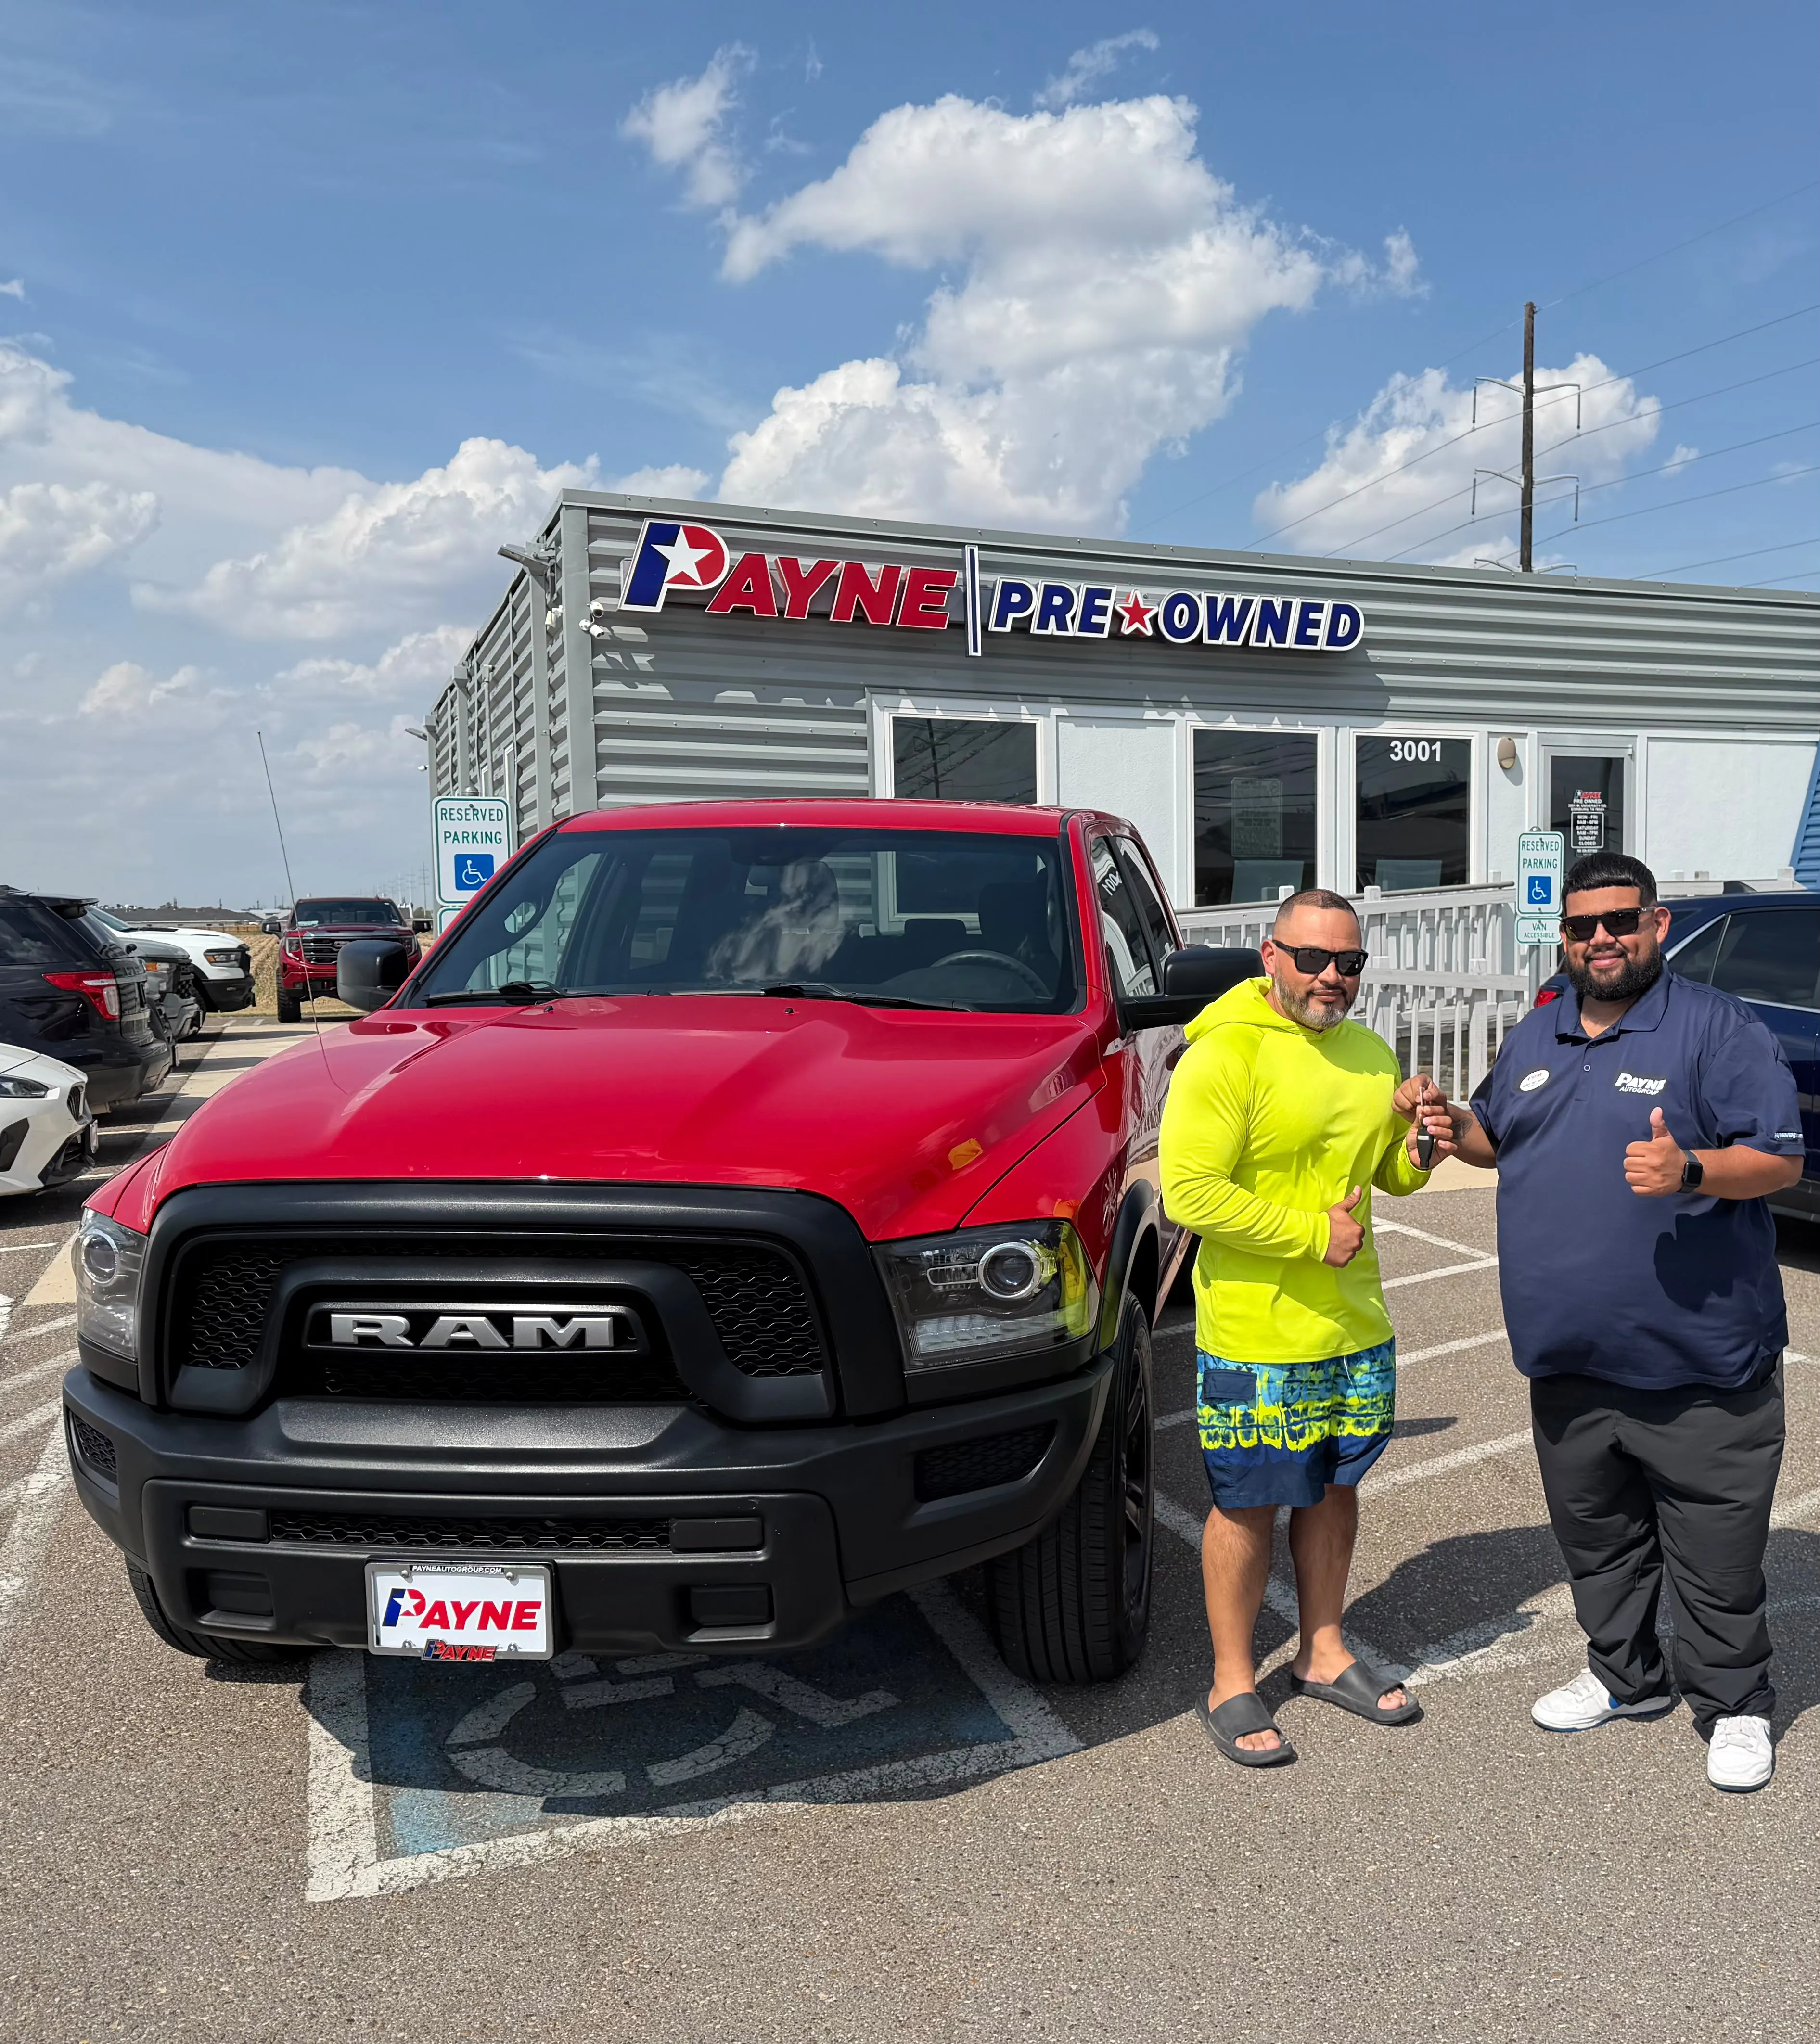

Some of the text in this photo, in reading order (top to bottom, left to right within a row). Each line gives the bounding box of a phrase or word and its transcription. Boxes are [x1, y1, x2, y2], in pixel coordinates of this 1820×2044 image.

[617, 518, 958, 629] PAYNE
[988, 576, 1365, 651] PRE OWNED
[1390, 741, 1441, 762] 3001
[440, 808, 503, 821] RESERVED
[444, 831, 502, 844] PARKING
[1522, 840, 1559, 851] RESERVED
[1523, 858, 1558, 869] PARKING
[1532, 923, 1547, 931] VAN
[1619, 1086, 1659, 1095] AUTOGROUP
[331, 1314, 614, 1347] RAM
[412, 1565, 503, 1575] PAYNEAUTOGROUP.COM
[382, 1588, 542, 1630] PAYNE
[424, 1639, 497, 1661] PAYNE
